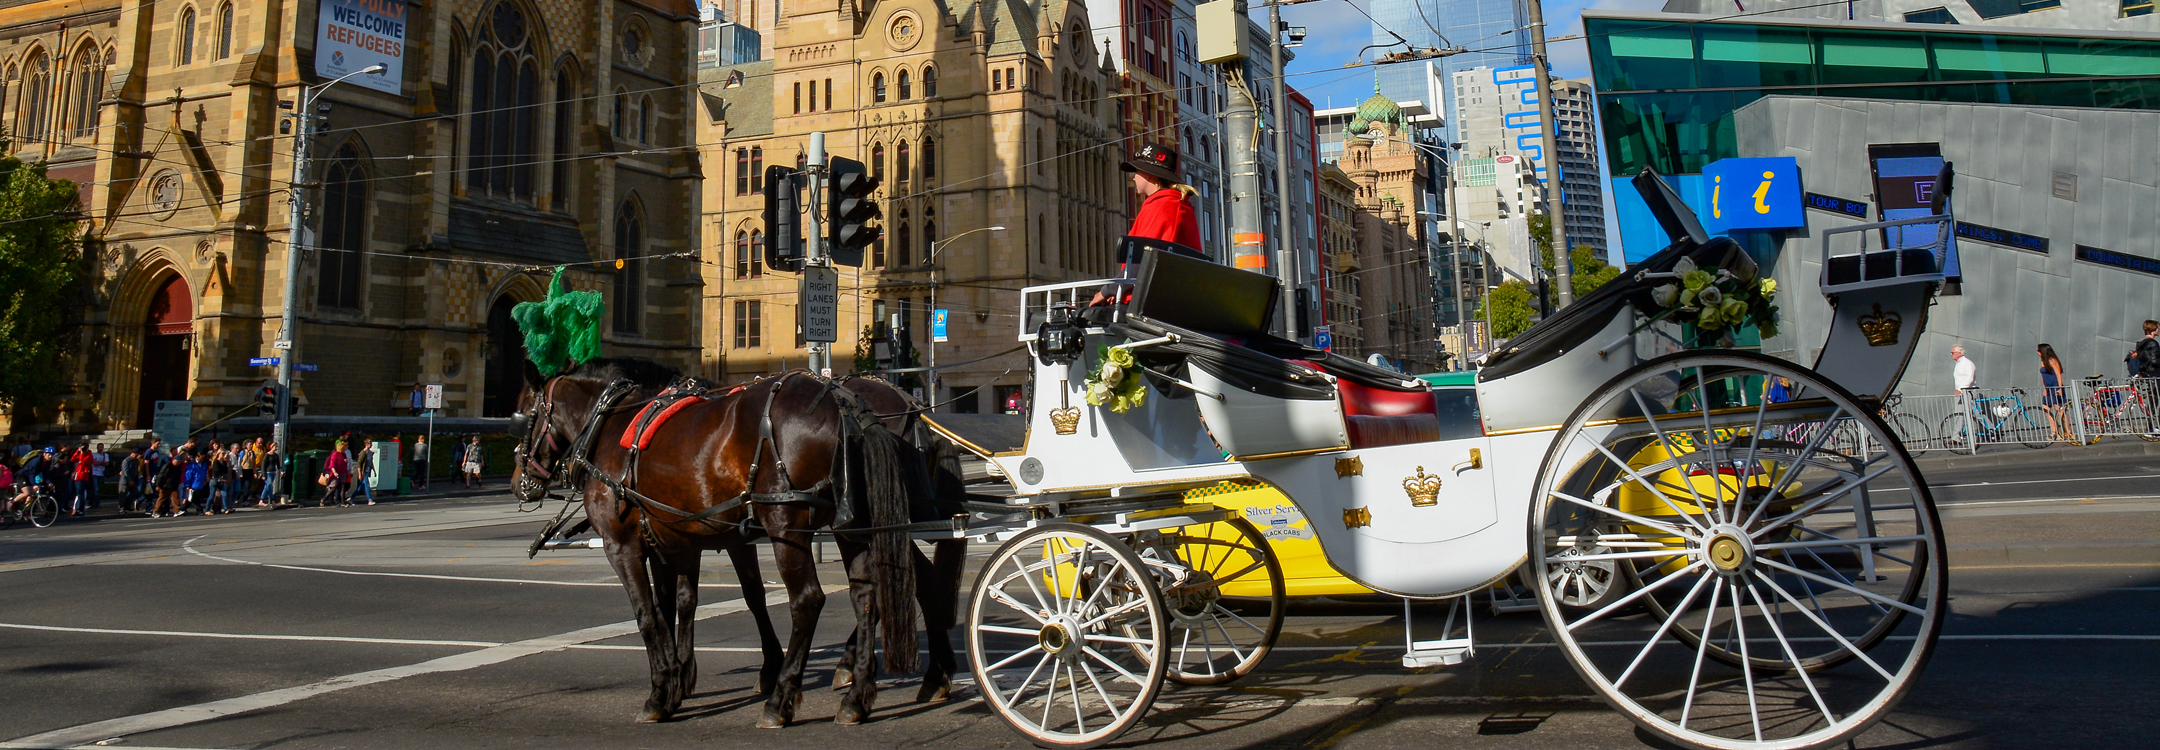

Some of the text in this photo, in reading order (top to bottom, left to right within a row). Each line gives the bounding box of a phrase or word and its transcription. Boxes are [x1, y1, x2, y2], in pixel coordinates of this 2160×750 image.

[334, 5, 403, 39] WELCOME
[327, 23, 401, 58] REFUGEES
[1810, 195, 1839, 209] TOUR
[2012, 234, 2041, 249] COME
[2088, 250, 2160, 273] DOWNSTAIRS
[810, 282, 832, 291] RIGHT
[808, 294, 833, 303] LANES
[810, 306, 831, 314] MUST
[810, 318, 830, 326] TURN
[810, 328, 831, 336] RIGHT
[1246, 507, 1273, 516] Silver
